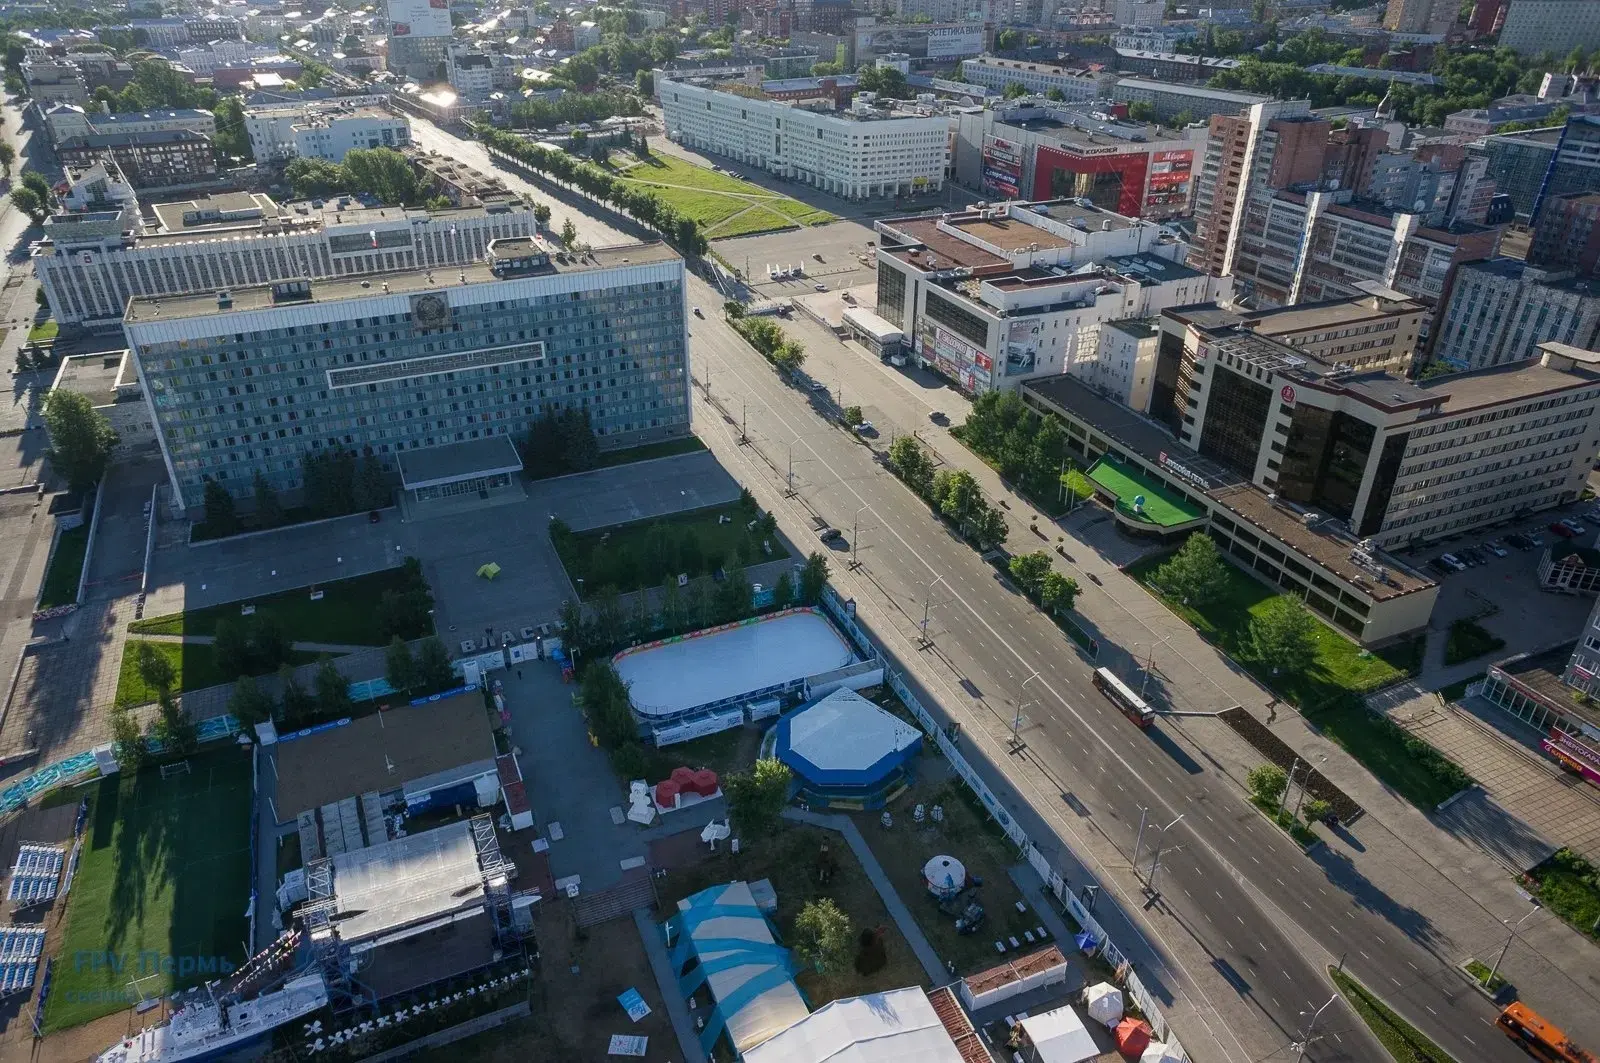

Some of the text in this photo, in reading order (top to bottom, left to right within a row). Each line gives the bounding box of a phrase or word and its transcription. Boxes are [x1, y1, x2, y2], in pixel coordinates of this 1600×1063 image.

[928, 25, 984, 37] ЭСТЕТИКА BMW
[1085, 146, 1118, 155] КОЛИЗЕЙ
[460, 620, 567, 653] ВЛАСТЬ
